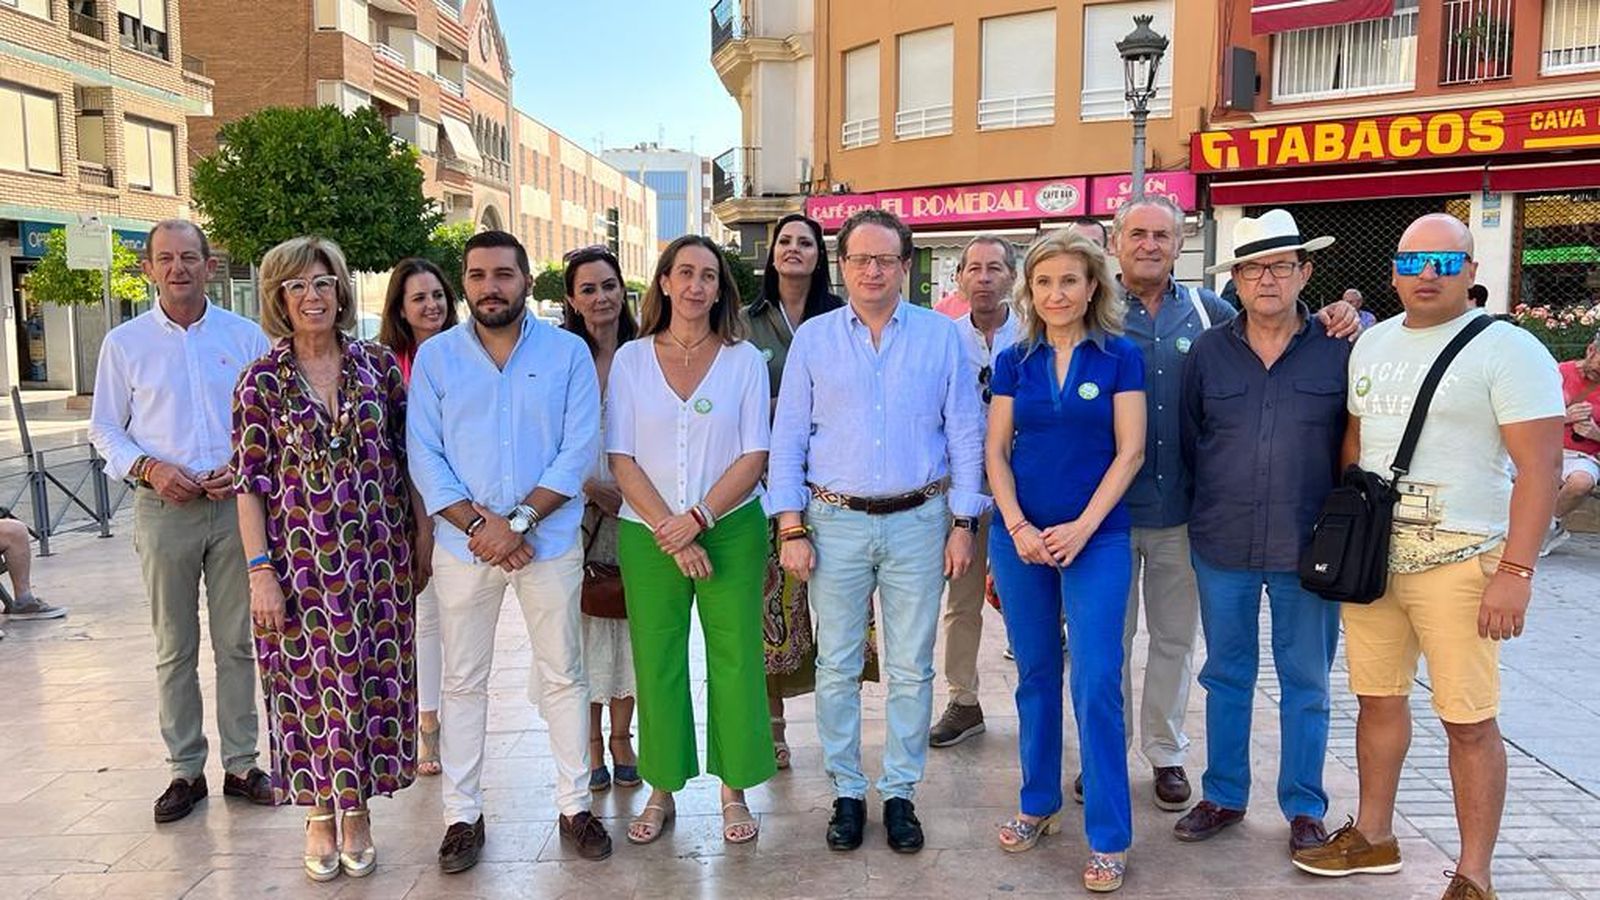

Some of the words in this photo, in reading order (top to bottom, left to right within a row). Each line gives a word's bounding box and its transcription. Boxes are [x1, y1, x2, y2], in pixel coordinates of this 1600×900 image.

[1530, 108, 1586, 131] CAVA
[1249, 110, 1506, 166] TABACOS
[1118, 177, 1167, 195] SÓN
[881, 198, 909, 218] EL
[912, 189, 1030, 217] ROMERAL
